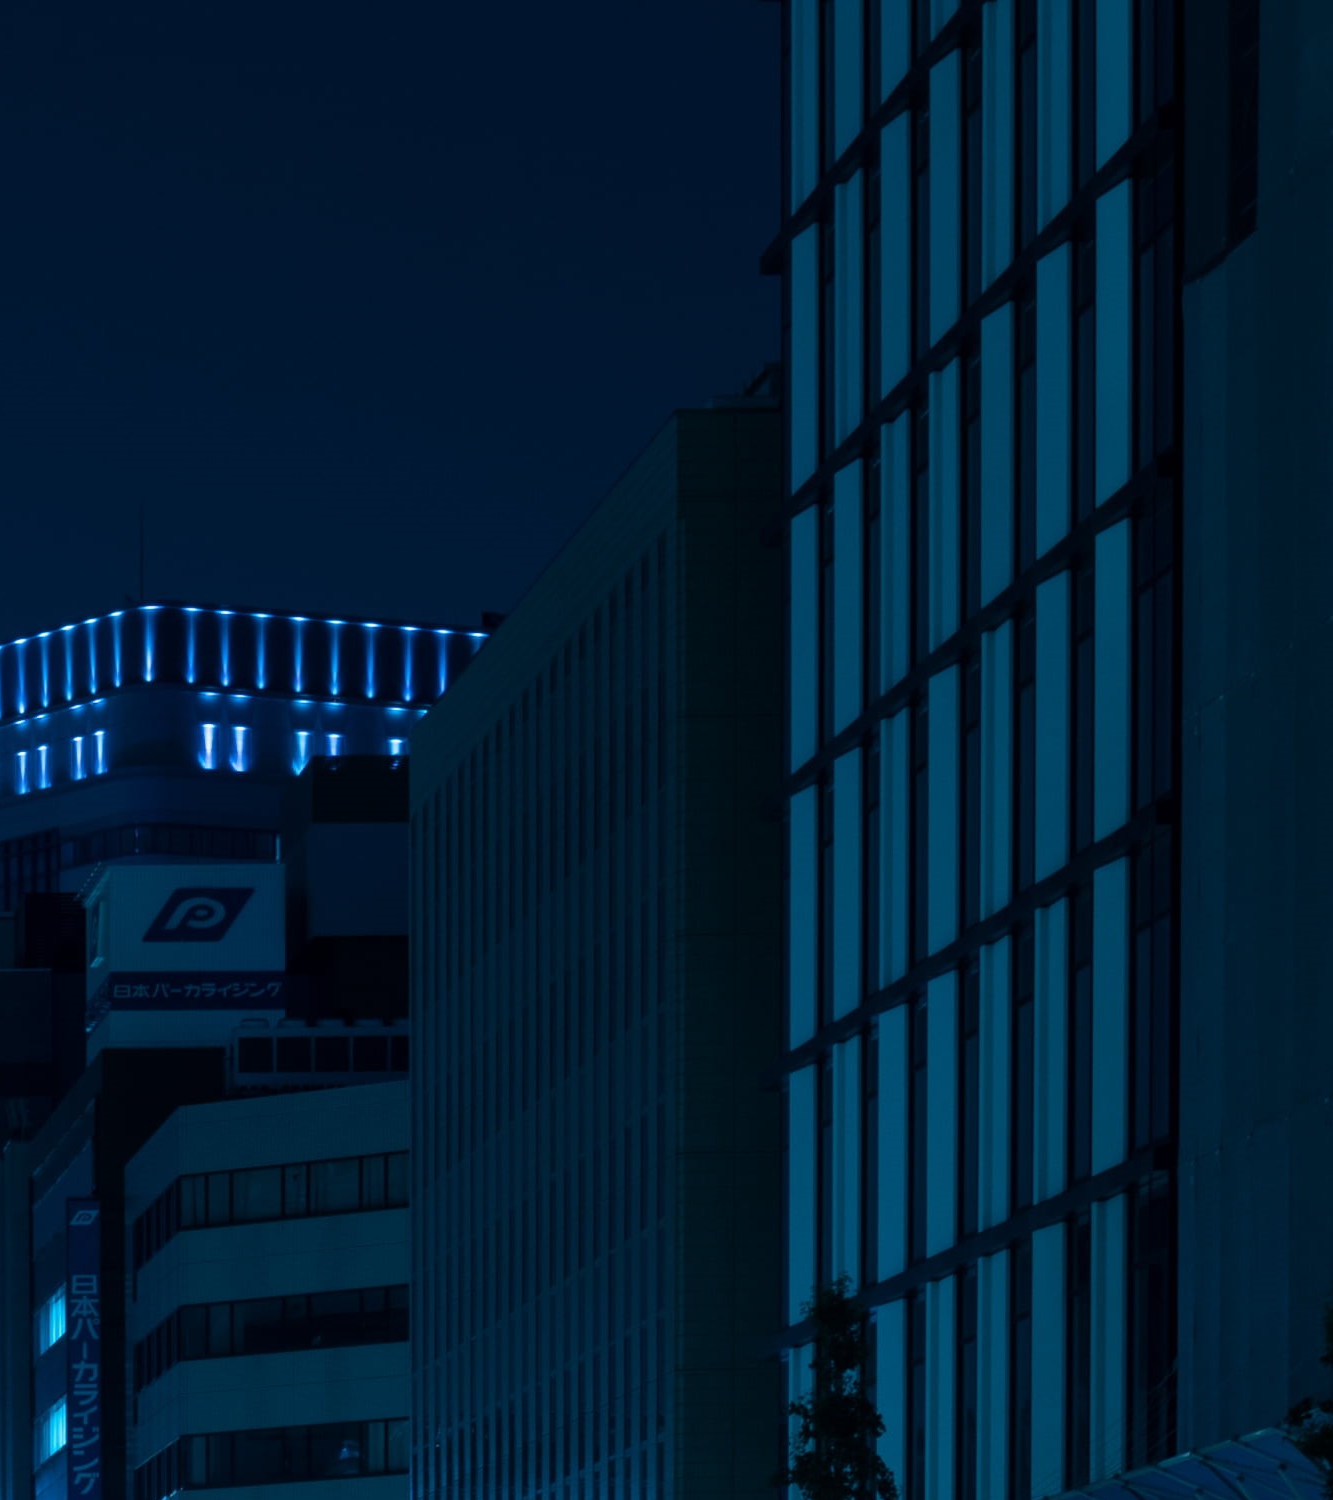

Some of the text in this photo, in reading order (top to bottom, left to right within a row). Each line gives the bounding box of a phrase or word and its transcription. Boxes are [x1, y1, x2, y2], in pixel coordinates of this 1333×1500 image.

[113, 980, 282, 1000] 日本パーカライジング
[71, 1274, 100, 1496] 日本パーカライジング
